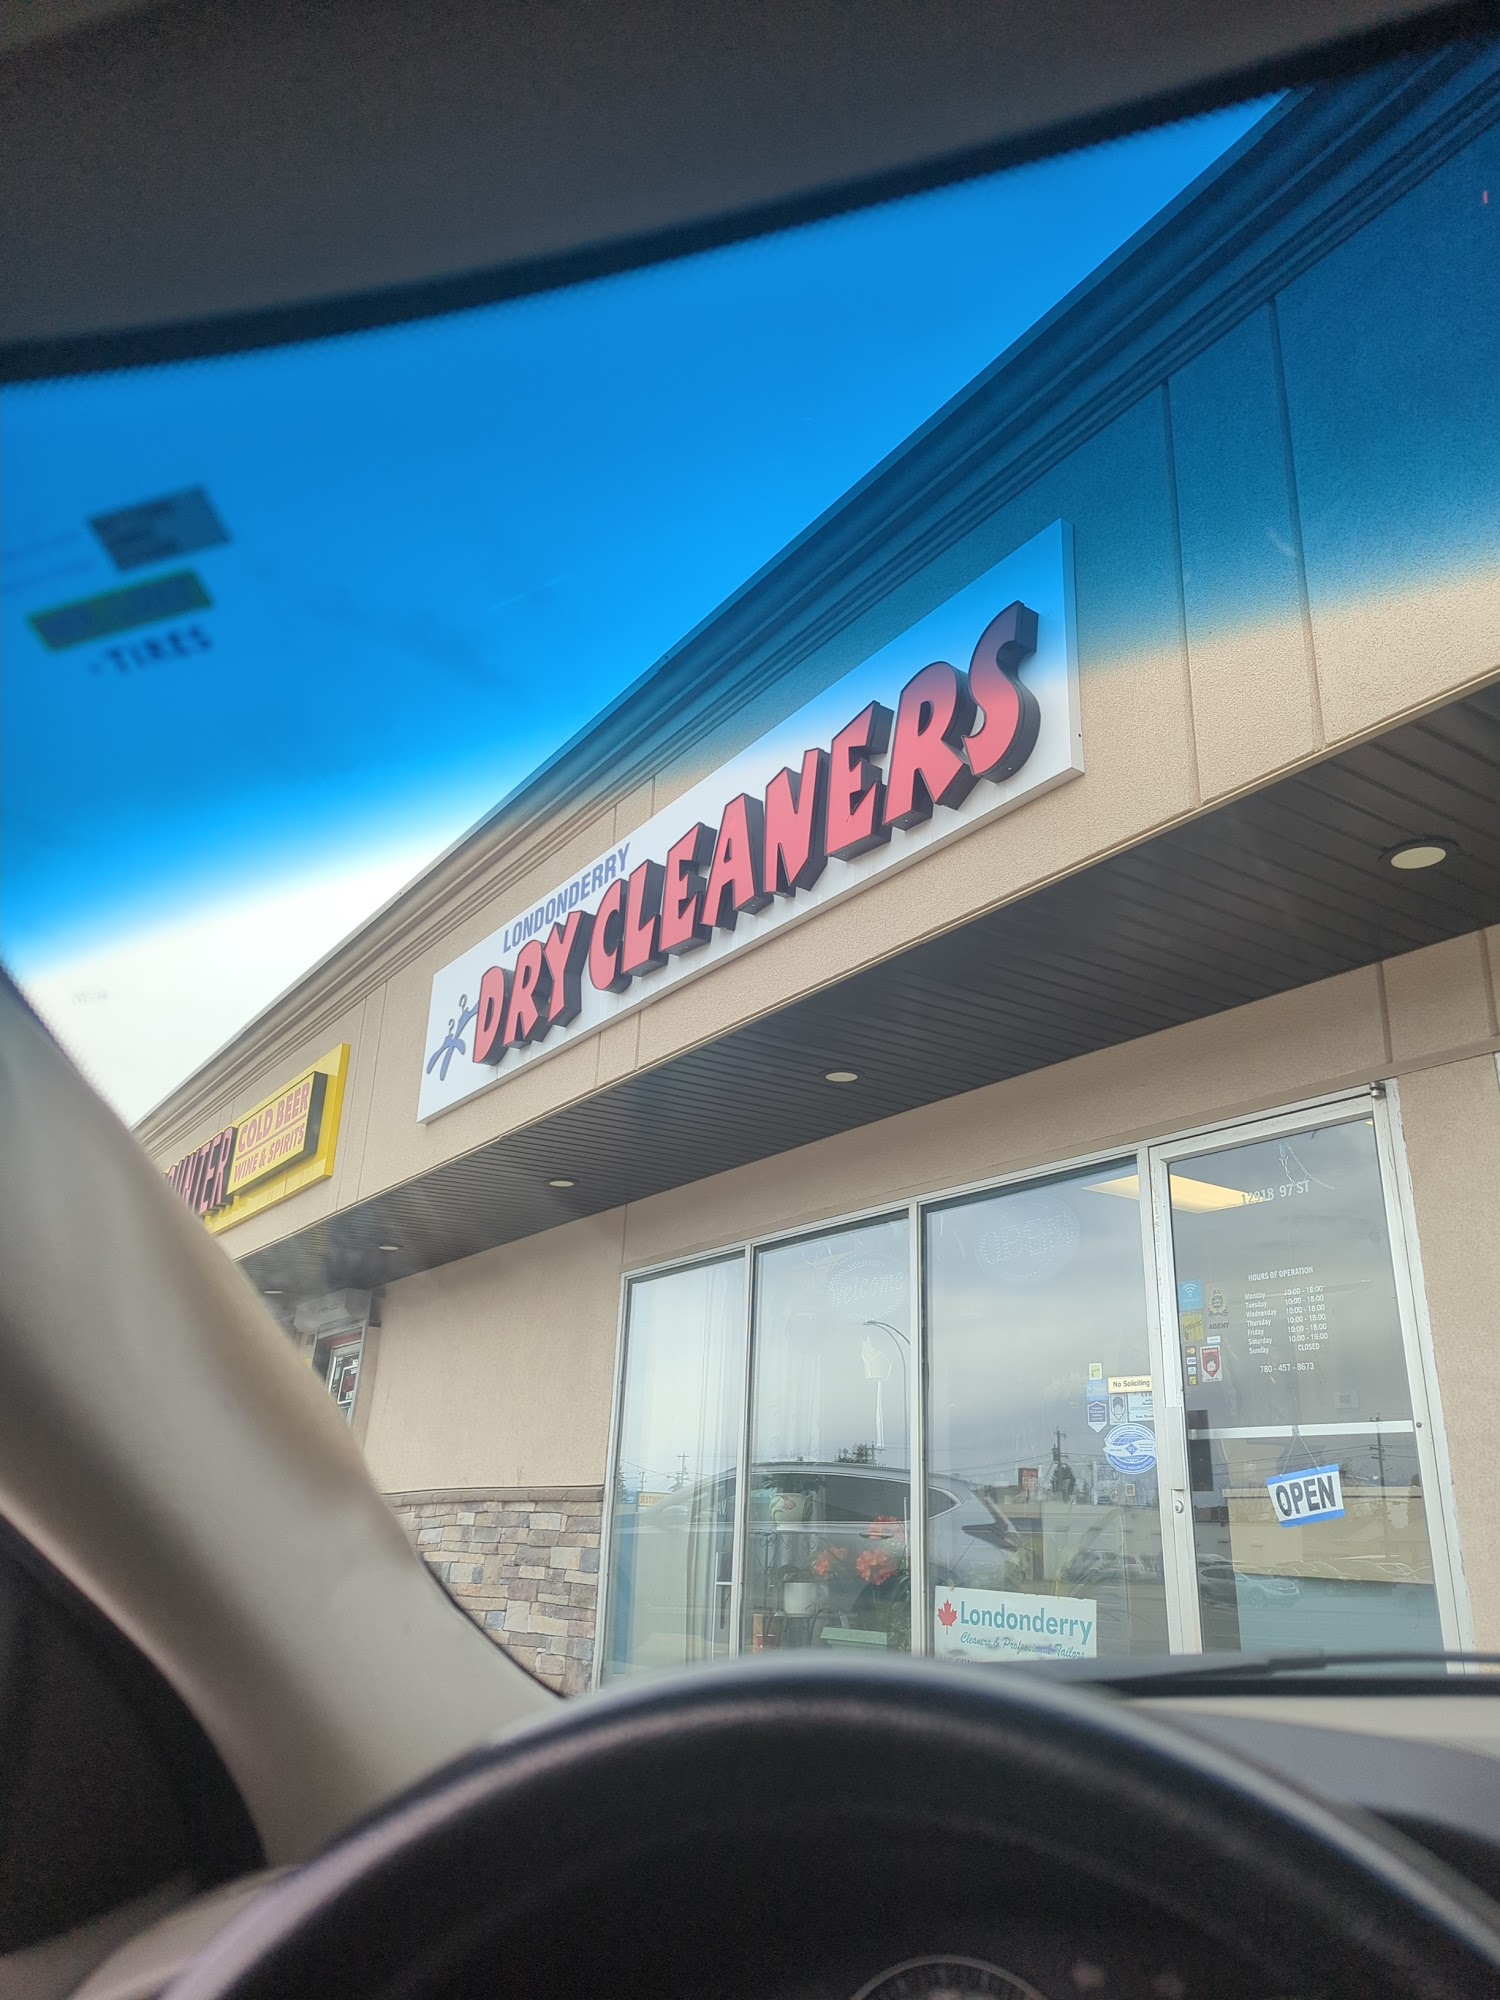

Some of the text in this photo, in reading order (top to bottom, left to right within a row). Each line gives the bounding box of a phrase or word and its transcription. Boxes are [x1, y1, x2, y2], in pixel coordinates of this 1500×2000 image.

[503, 841, 630, 954] LONDONDERRY
[238, 1081, 311, 1152] COLD BEER
[233, 1122, 305, 1183] WINE & SPIRITS
[1279, 1183, 1293, 1198] 97
[1296, 1180, 1310, 1194] ST
[1248, 1266, 1314, 1281] HOURS OF OPERATION
[1284, 1288, 1301, 1296] 10:00
[1306, 1285, 1323, 1294] 18:00
[1245, 1301, 1267, 1309] Tuesday
[1285, 1297, 1302, 1305] 10:00
[1307, 1295, 1324, 1303] 18:00
[1246, 1309, 1277, 1318] Wednesday
[1286, 1306, 1302, 1314] 10:00
[1308, 1304, 1325, 1312] 18:00
[1247, 1319, 1272, 1327] Thursday
[1287, 1316, 1304, 1324] 10:00
[1309, 1313, 1327, 1322] 18:00
[1288, 1325, 1304, 1333] 10:00
[1310, 1323, 1327, 1331] 18:00
[1248, 1337, 1273, 1345] Saturday
[1288, 1334, 1305, 1342] 10:00
[1249, 1343, 1320, 1355] Sunday CLOSED
[1260, 1365, 1273, 1373] 780
[1278, 1363, 1291, 1372] 457
[1297, 1362, 1315, 1371] 8673
[1123, 1379, 1150, 1387] Soliciting
[1276, 1475, 1336, 1517] OPEN
[960, 1601, 1093, 1645] Londonderry
[960, 1631, 1085, 1659] Cleaners & Professional Tailors
